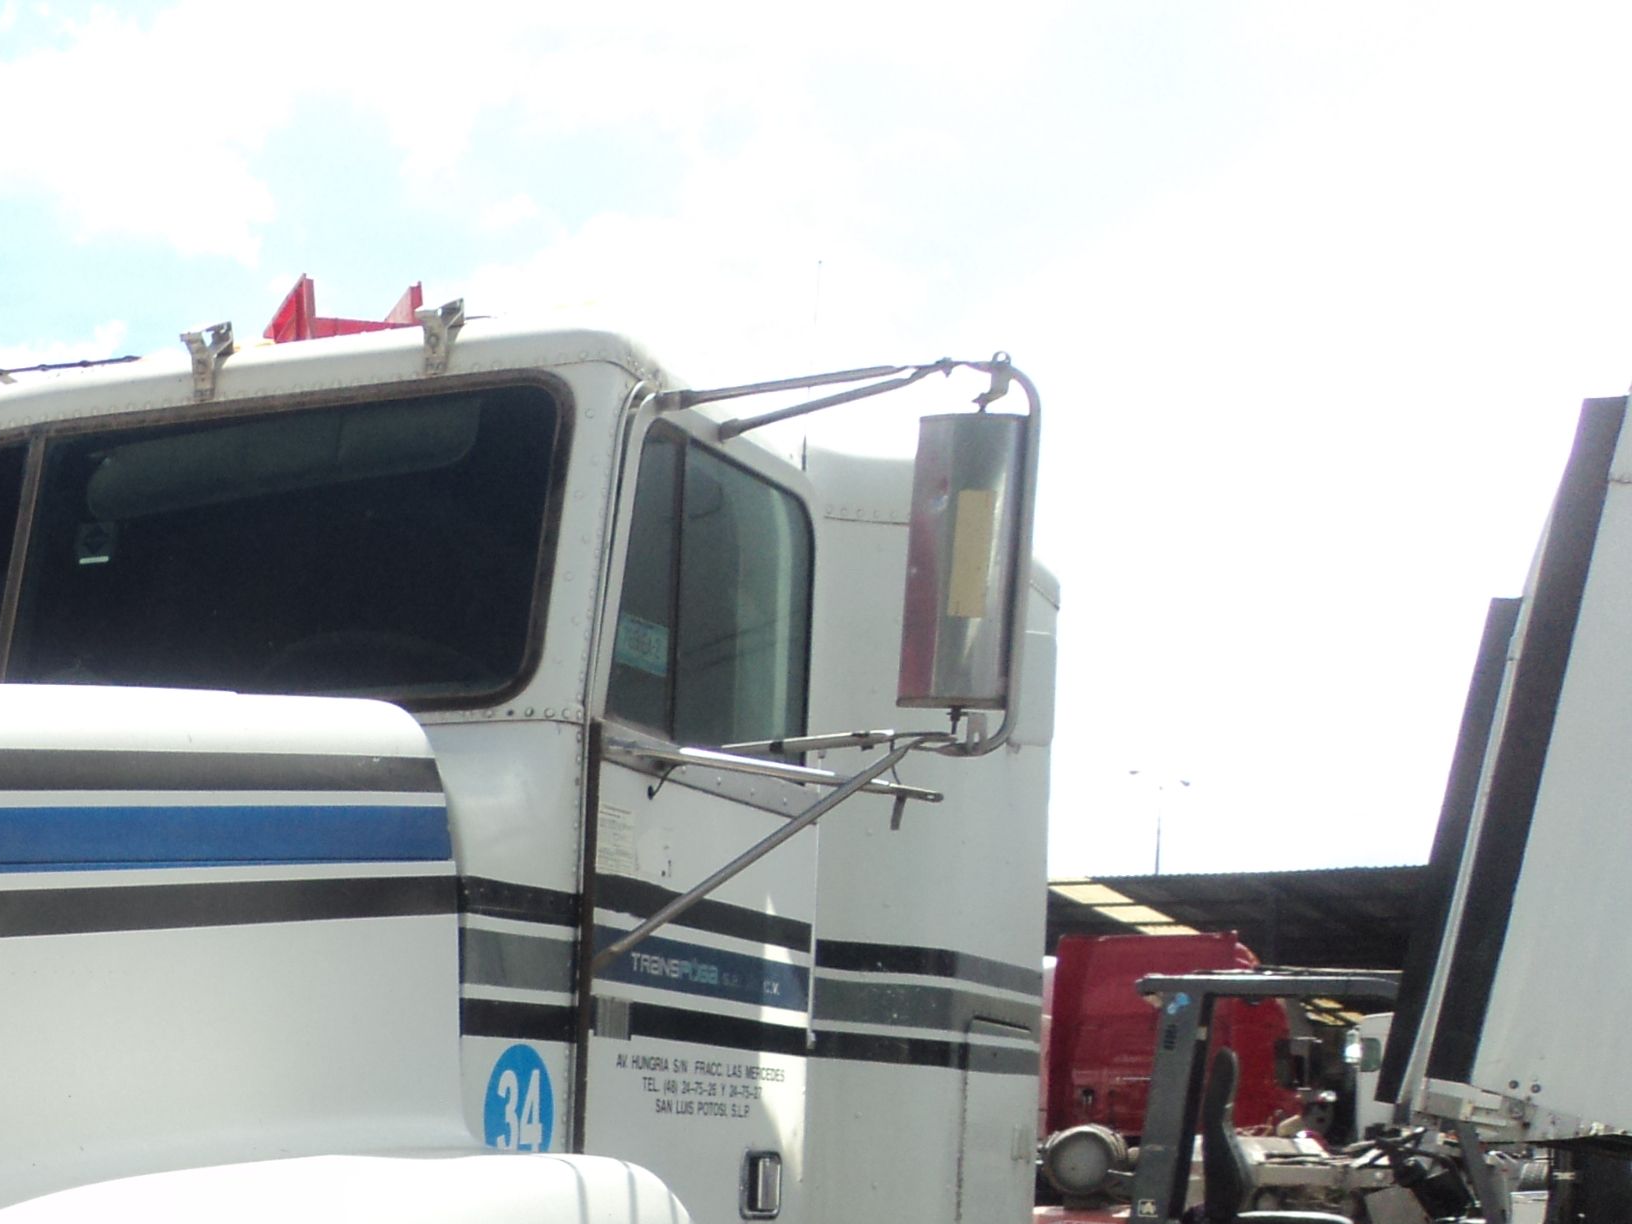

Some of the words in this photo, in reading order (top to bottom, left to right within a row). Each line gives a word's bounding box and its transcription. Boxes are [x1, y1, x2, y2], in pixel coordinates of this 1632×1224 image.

[631, 1055, 669, 1071] HUNGRIA
[726, 1063, 742, 1078] LAS
[745, 1066, 785, 1083] MERCEDES
[495, 1066, 543, 1152] 34
[655, 1098, 673, 1114] SAN
[675, 1100, 694, 1116] LUIS
